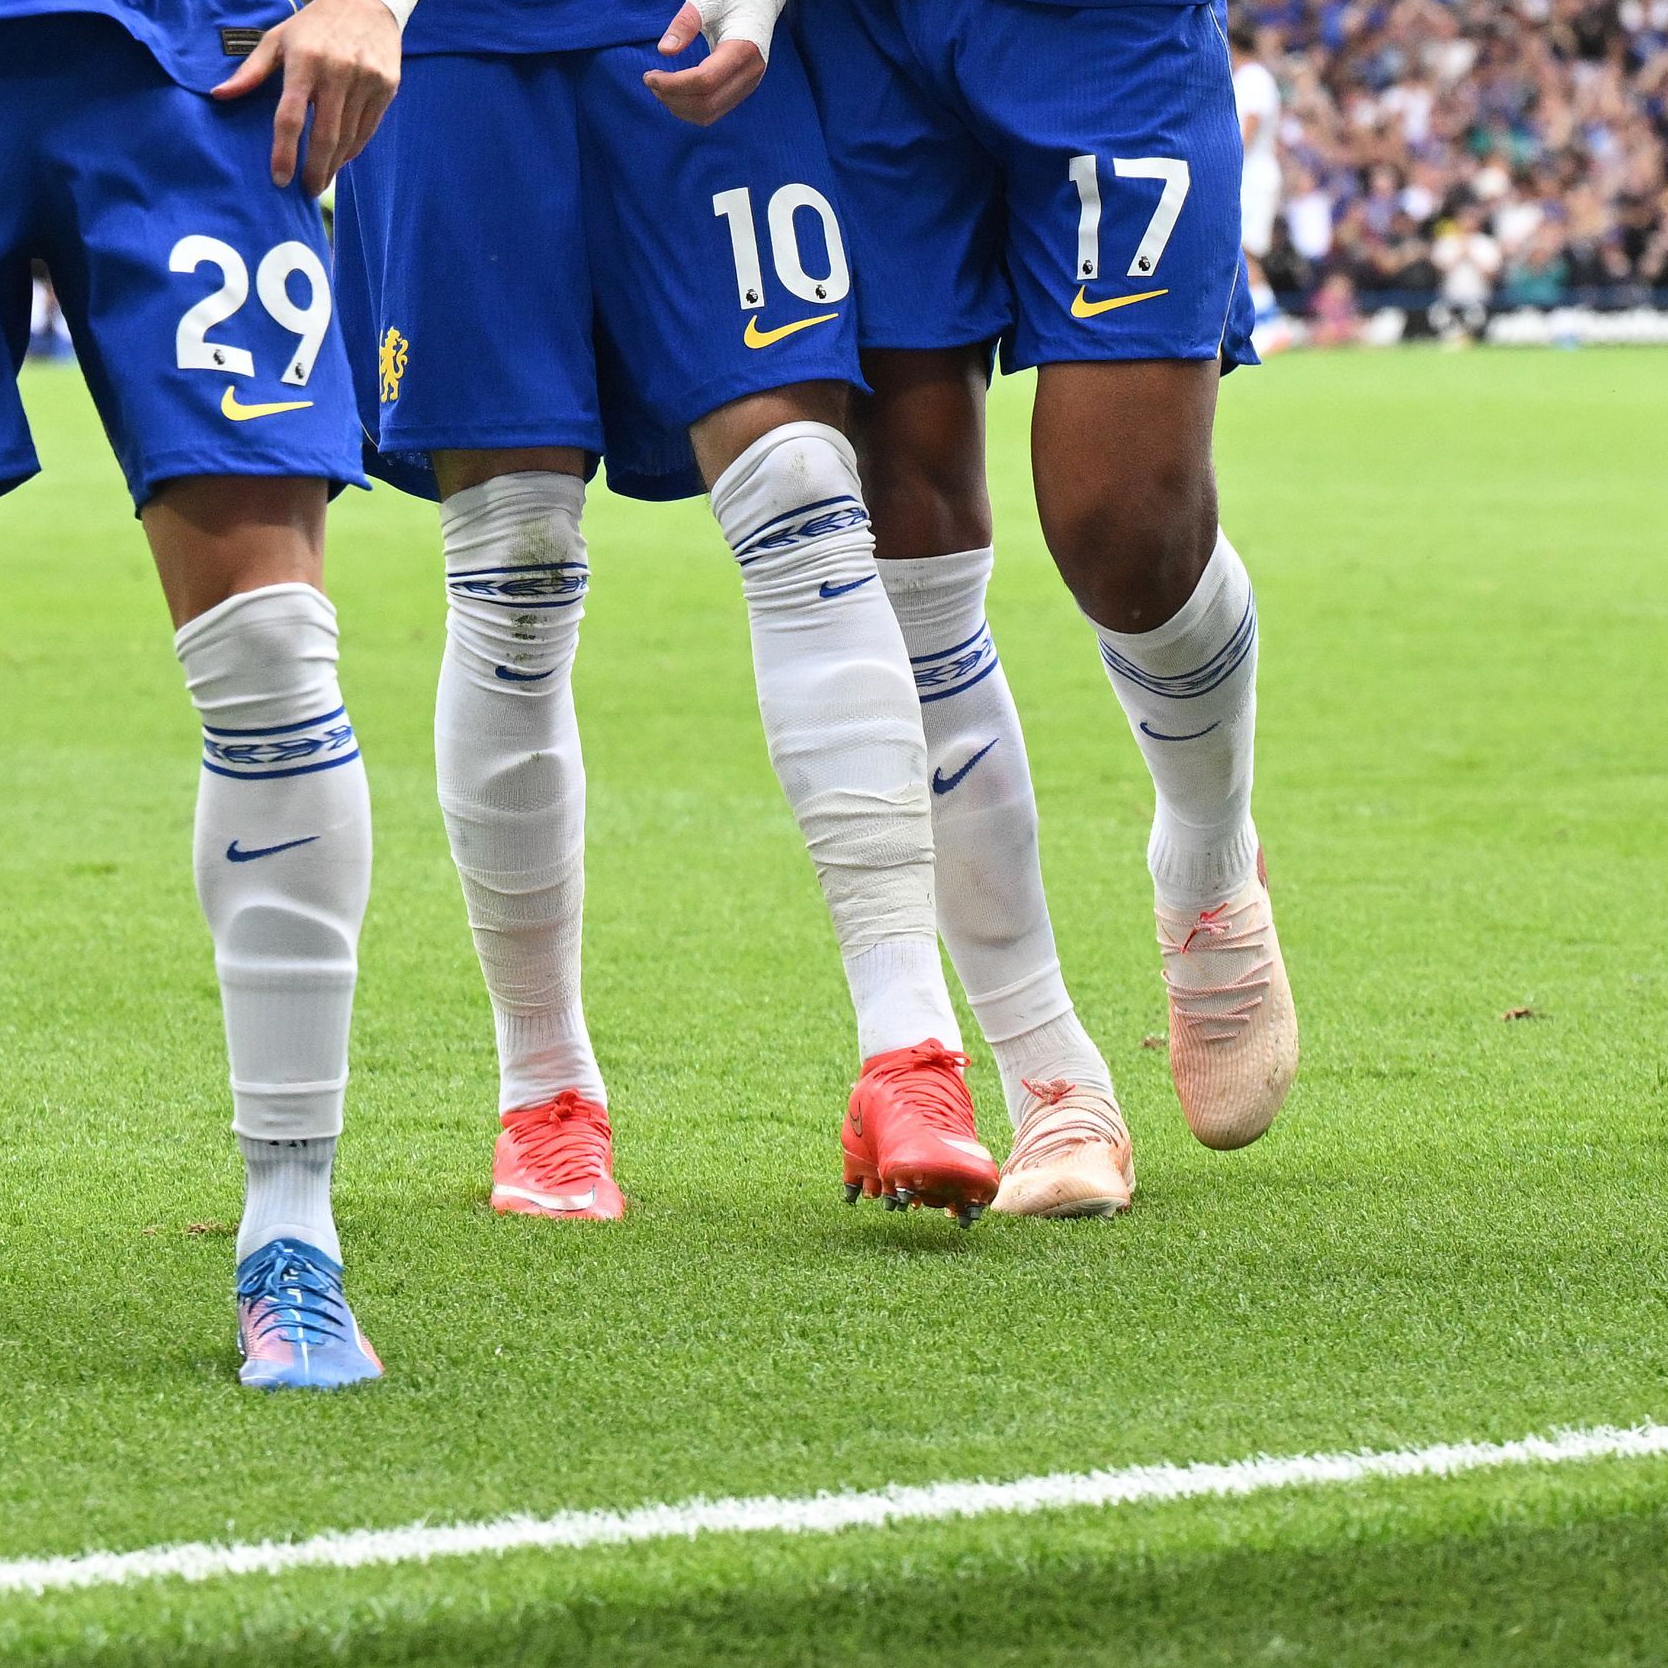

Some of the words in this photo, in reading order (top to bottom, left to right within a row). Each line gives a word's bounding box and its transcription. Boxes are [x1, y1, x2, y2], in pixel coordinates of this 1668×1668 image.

[713, 182, 851, 311] 10
[1068, 154, 1191, 281] 17
[167, 234, 333, 387] 29
